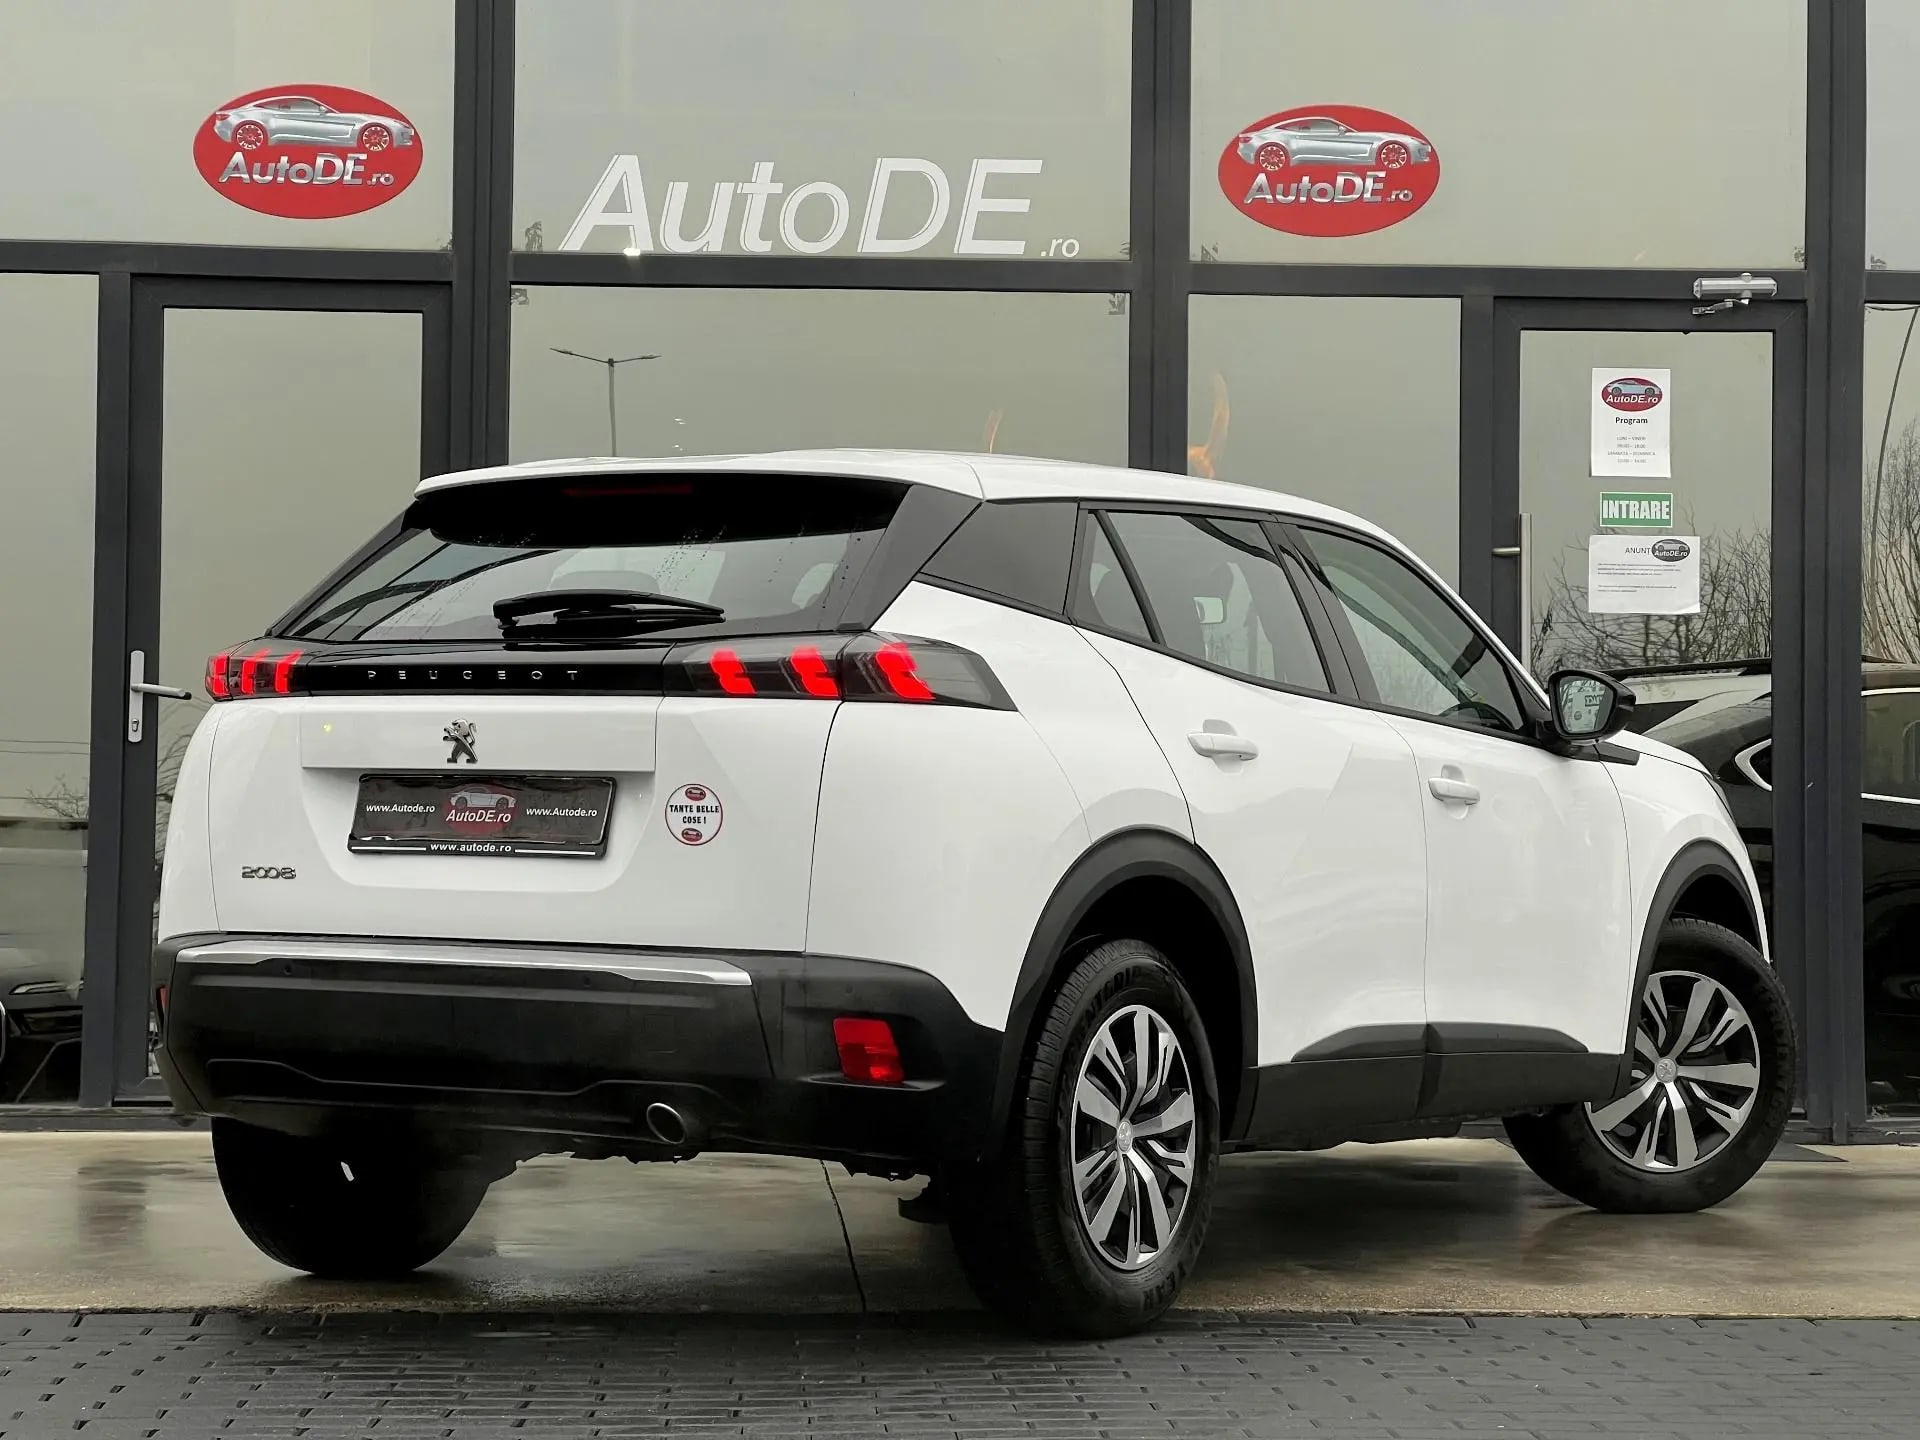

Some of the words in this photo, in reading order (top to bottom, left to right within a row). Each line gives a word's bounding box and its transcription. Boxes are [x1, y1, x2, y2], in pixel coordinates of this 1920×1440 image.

[1606, 394, 1659, 404] AutoDE.ro
[1615, 416, 1648, 425] Program
[1602, 499, 1670, 520] INTRARE
[367, 670, 578, 681] PEUGEOT
[366, 803, 435, 813] www.Autode.ro
[446, 809, 511, 823] AutoDE.ro
[526, 807, 597, 817] www.Autode.ro
[669, 804, 693, 813] TANTE
[696, 805, 719, 813] BELLE
[682, 816, 701, 824] COSE
[430, 843, 512, 852] www.autode.ro
[241, 866, 296, 879] 2008
